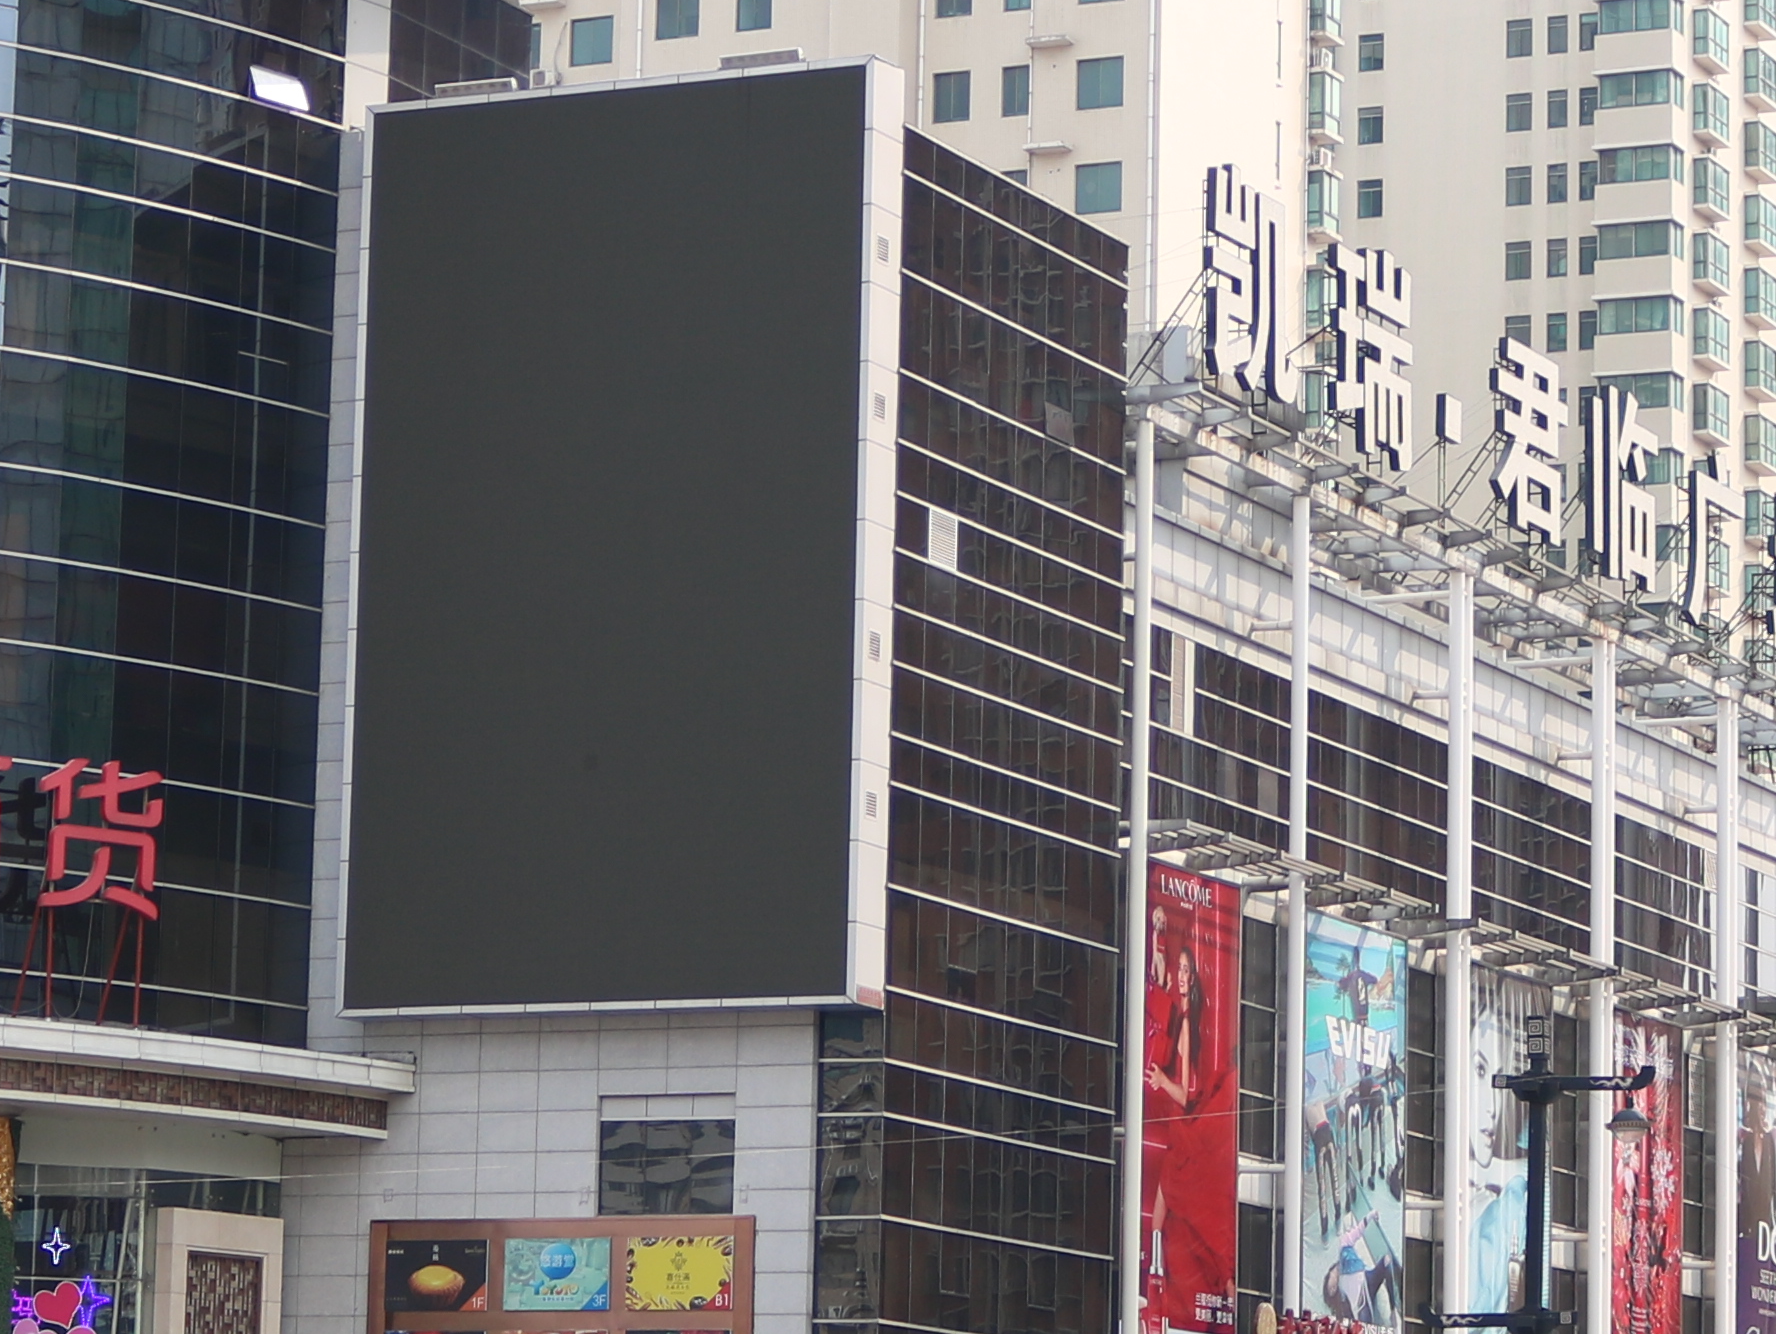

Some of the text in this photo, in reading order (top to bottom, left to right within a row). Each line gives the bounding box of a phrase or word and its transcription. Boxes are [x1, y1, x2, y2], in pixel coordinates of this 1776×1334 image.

[1326, 1015, 1390, 1069] EVISU
[472, 1297, 484, 1308] 1F
[592, 1295, 606, 1307] 3F
[715, 1294, 729, 1307] B1
